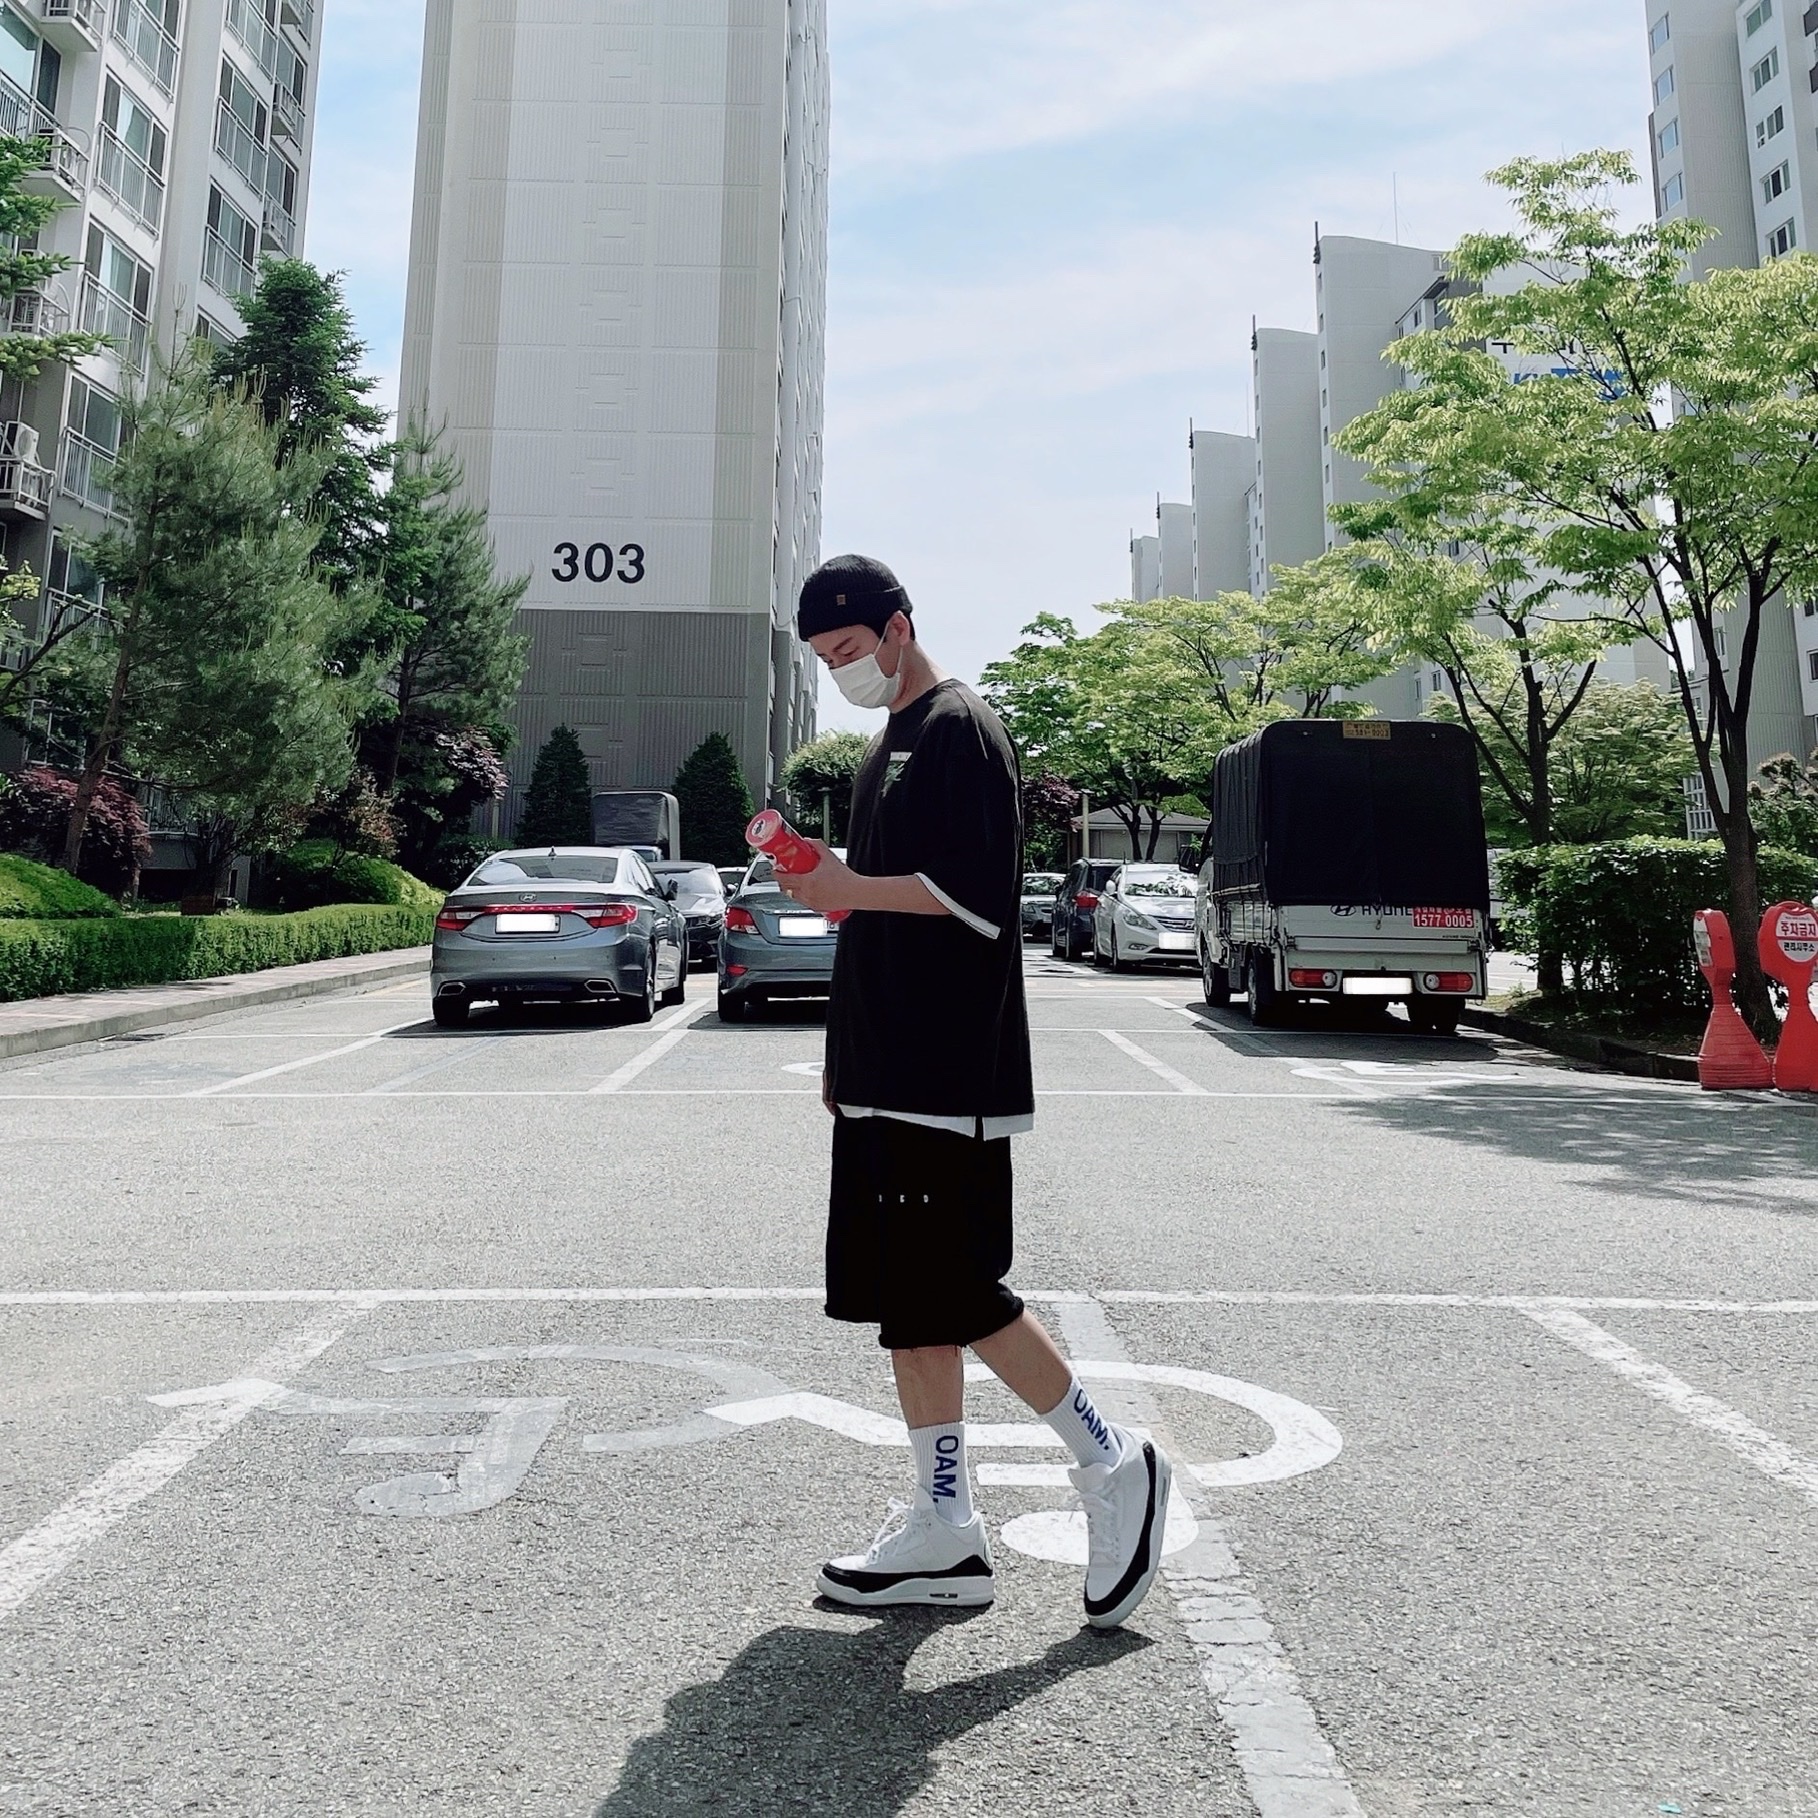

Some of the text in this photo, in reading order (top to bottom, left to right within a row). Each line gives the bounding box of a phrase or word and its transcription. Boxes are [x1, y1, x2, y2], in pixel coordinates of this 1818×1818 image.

[551, 542, 645, 584] 303
[1415, 914, 1473, 928] 1577 0005
